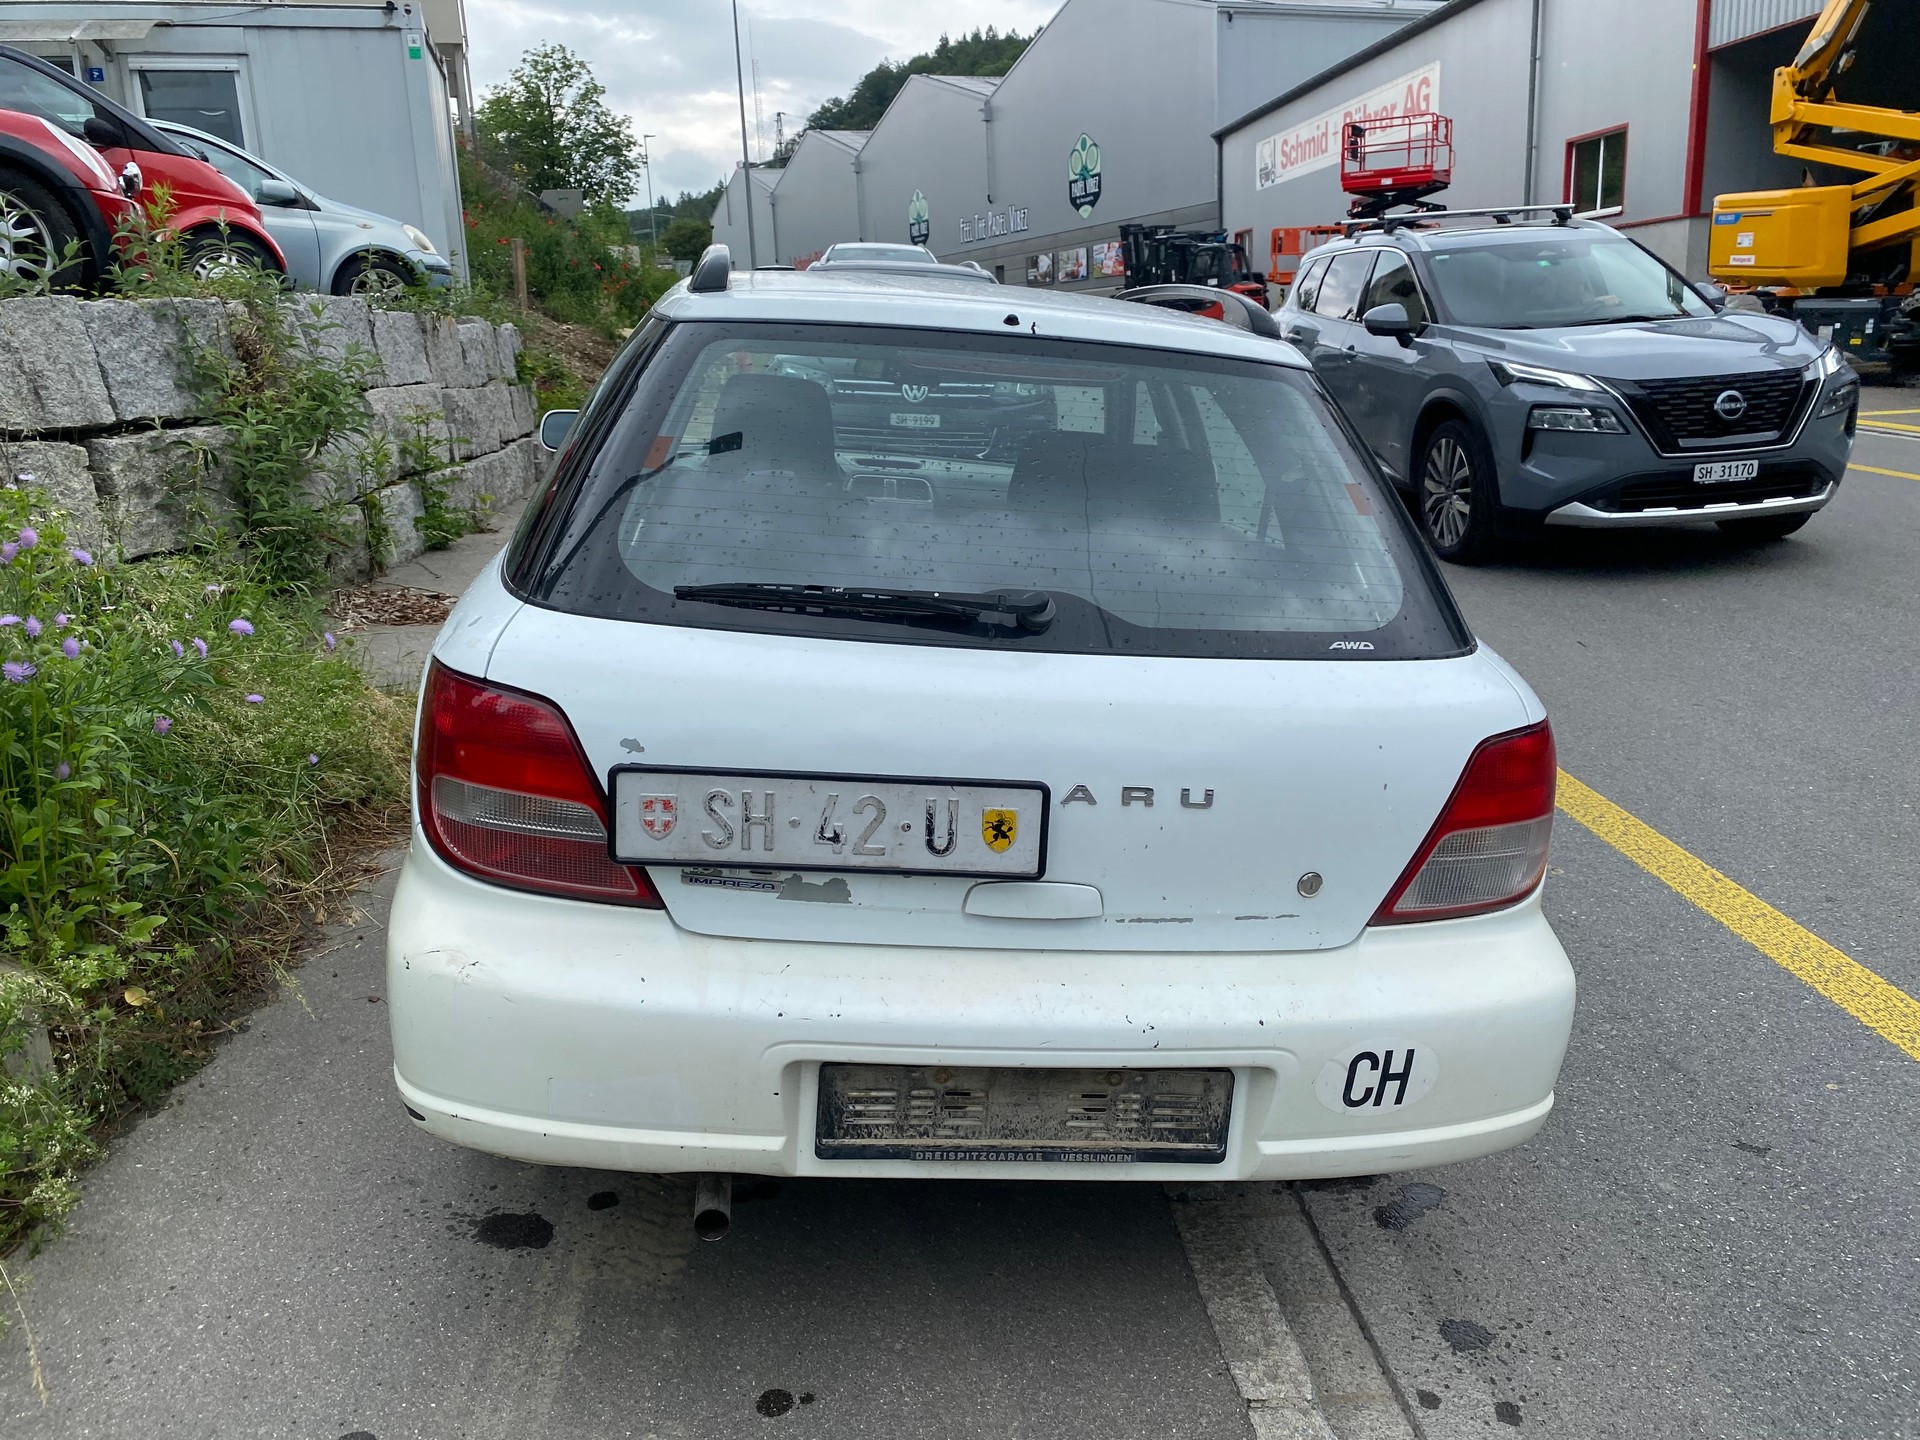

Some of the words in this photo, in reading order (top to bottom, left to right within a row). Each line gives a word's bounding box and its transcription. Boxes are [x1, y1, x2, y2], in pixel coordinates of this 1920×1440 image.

[1280, 121, 1329, 169] Schmid
[1402, 76, 1431, 123] AG
[1713, 402, 1748, 410] NISSAN
[1698, 466, 1713, 480] SH
[1719, 463, 1755, 478] 31170
[1329, 641, 1375, 650] AWD
[702, 788, 776, 851] SH
[813, 793, 887, 856] 42
[924, 797, 960, 858] U
[688, 877, 776, 890] IMPREZA
[1342, 1048, 1416, 1108] CH
[915, 1151, 1043, 1161] DREISPITZGARAGE
[1060, 1153, 1133, 1163] UESSLINGEN
